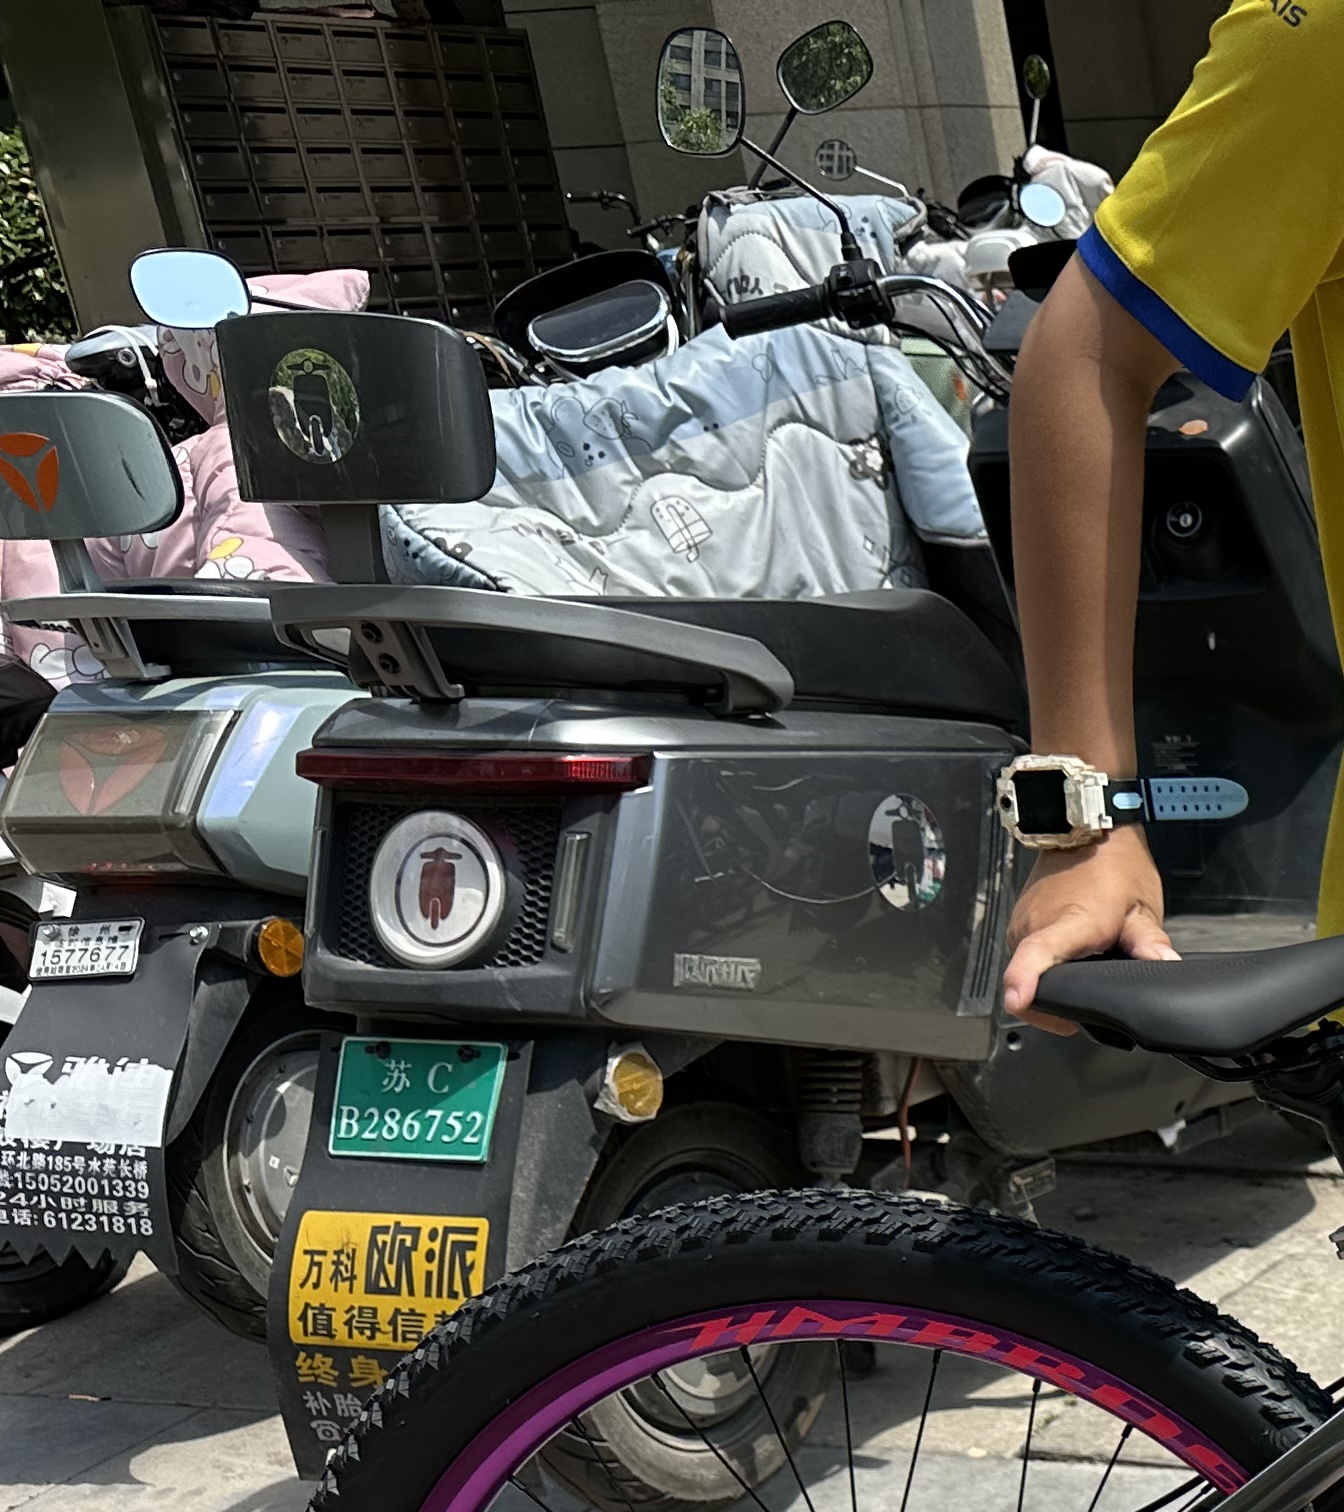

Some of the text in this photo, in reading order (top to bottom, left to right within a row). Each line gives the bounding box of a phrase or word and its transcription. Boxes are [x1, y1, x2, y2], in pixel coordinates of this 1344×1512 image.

[381, 1059, 453, 1094] 苏 C
[337, 1105, 484, 1144] B286752
[299, 1221, 480, 1299] 万科 欧派
[298, 1301, 453, 1344] 值得信
